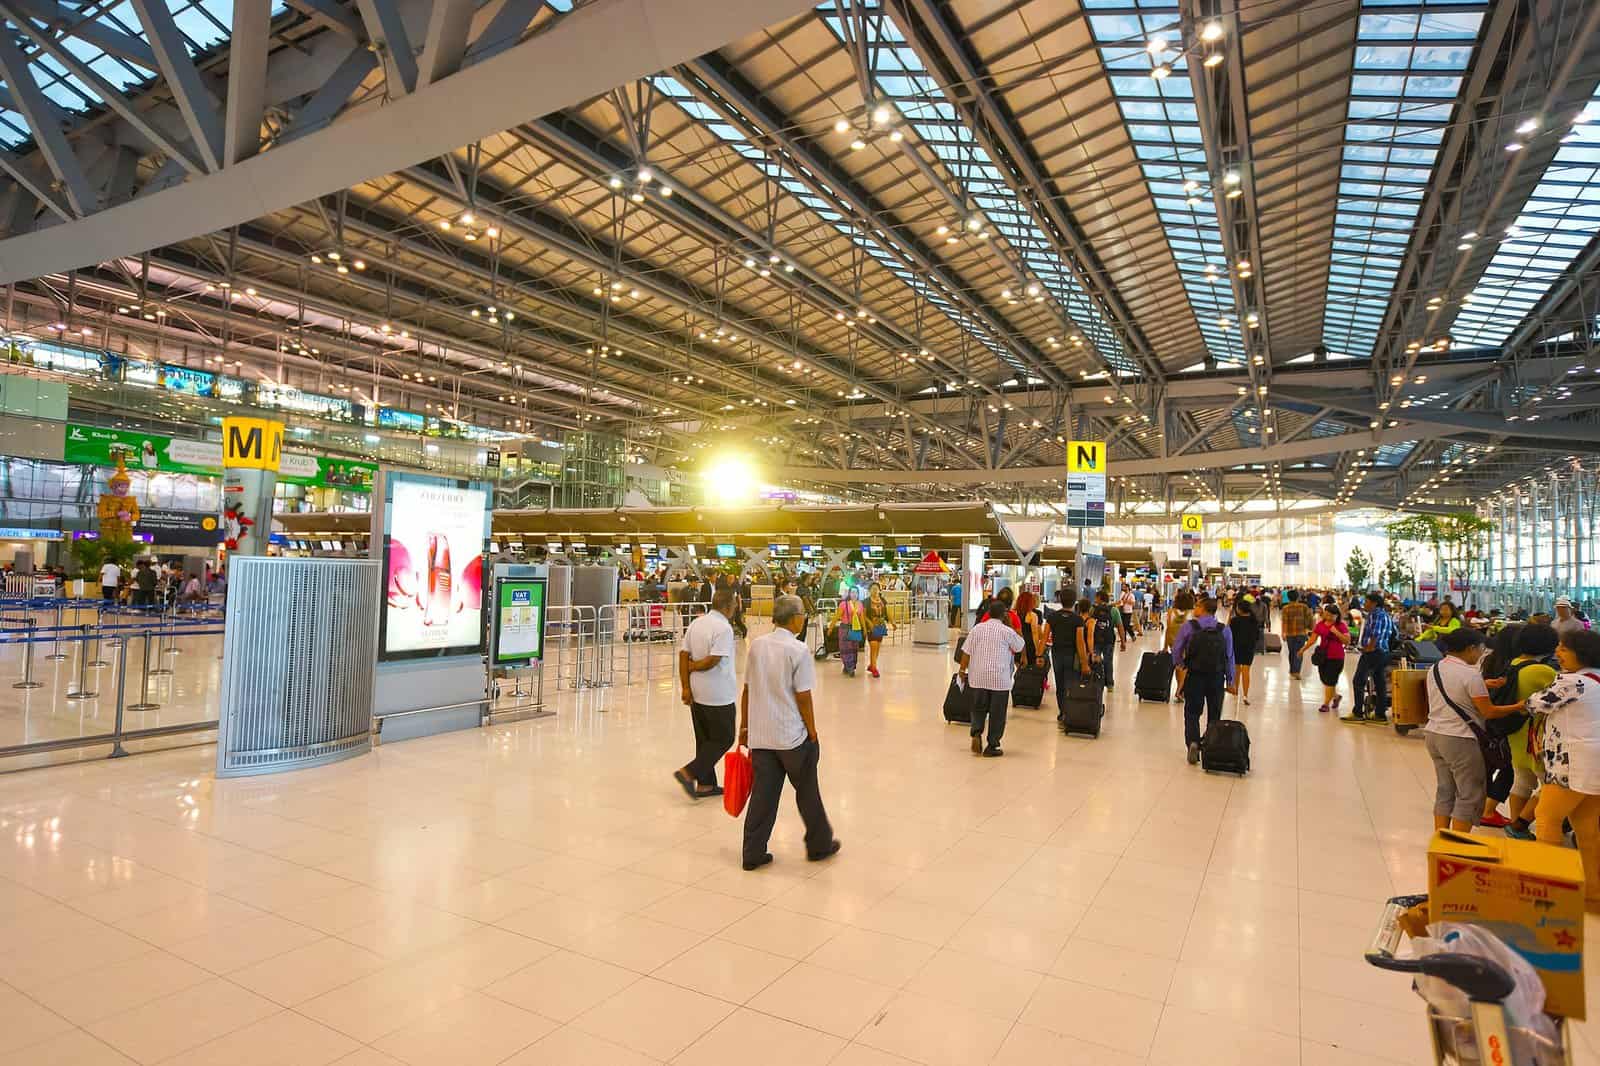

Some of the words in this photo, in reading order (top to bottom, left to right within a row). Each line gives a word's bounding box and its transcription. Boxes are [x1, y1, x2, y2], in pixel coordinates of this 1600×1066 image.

[229, 426, 262, 459] M
[1077, 446, 1096, 469] N
[1186, 517, 1198, 529] Q
